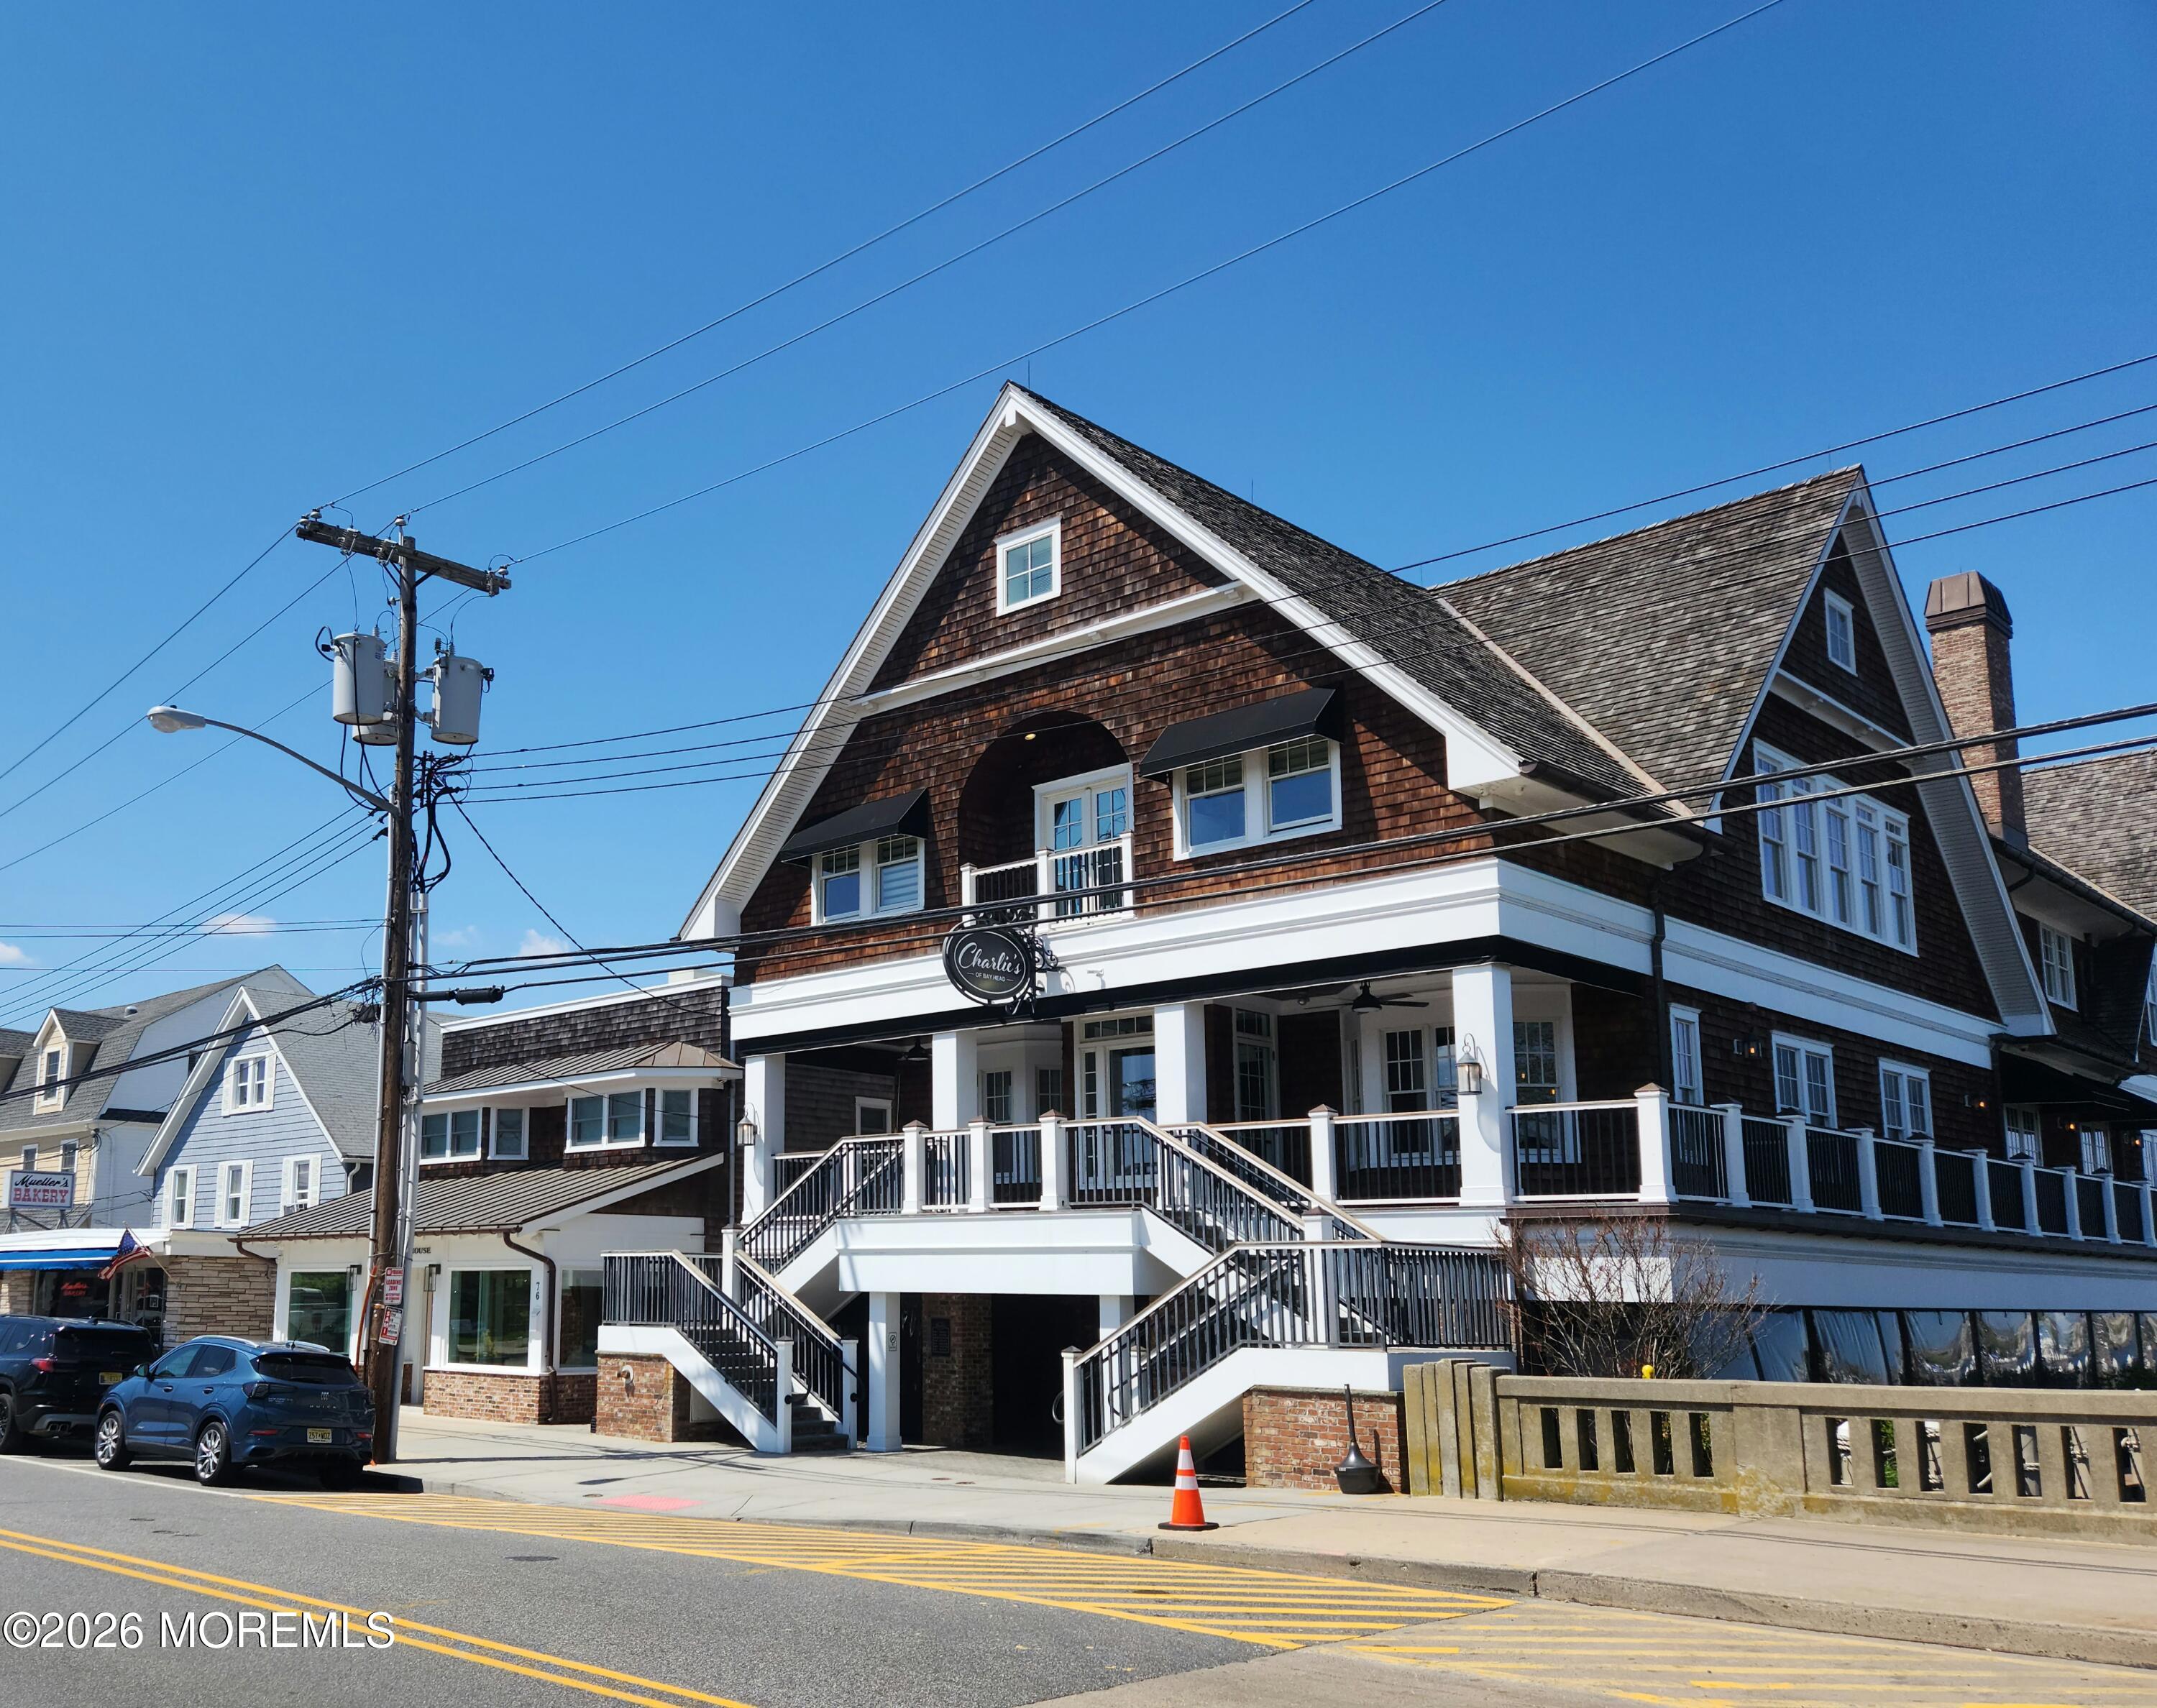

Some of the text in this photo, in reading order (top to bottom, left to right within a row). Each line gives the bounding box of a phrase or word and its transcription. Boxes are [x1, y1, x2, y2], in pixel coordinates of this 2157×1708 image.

[958, 942, 1022, 975] Charlie's
[14, 1175, 69, 1188] Mueller's
[13, 1188, 69, 1203] BAKERY
[536, 1282, 540, 1300] 76
